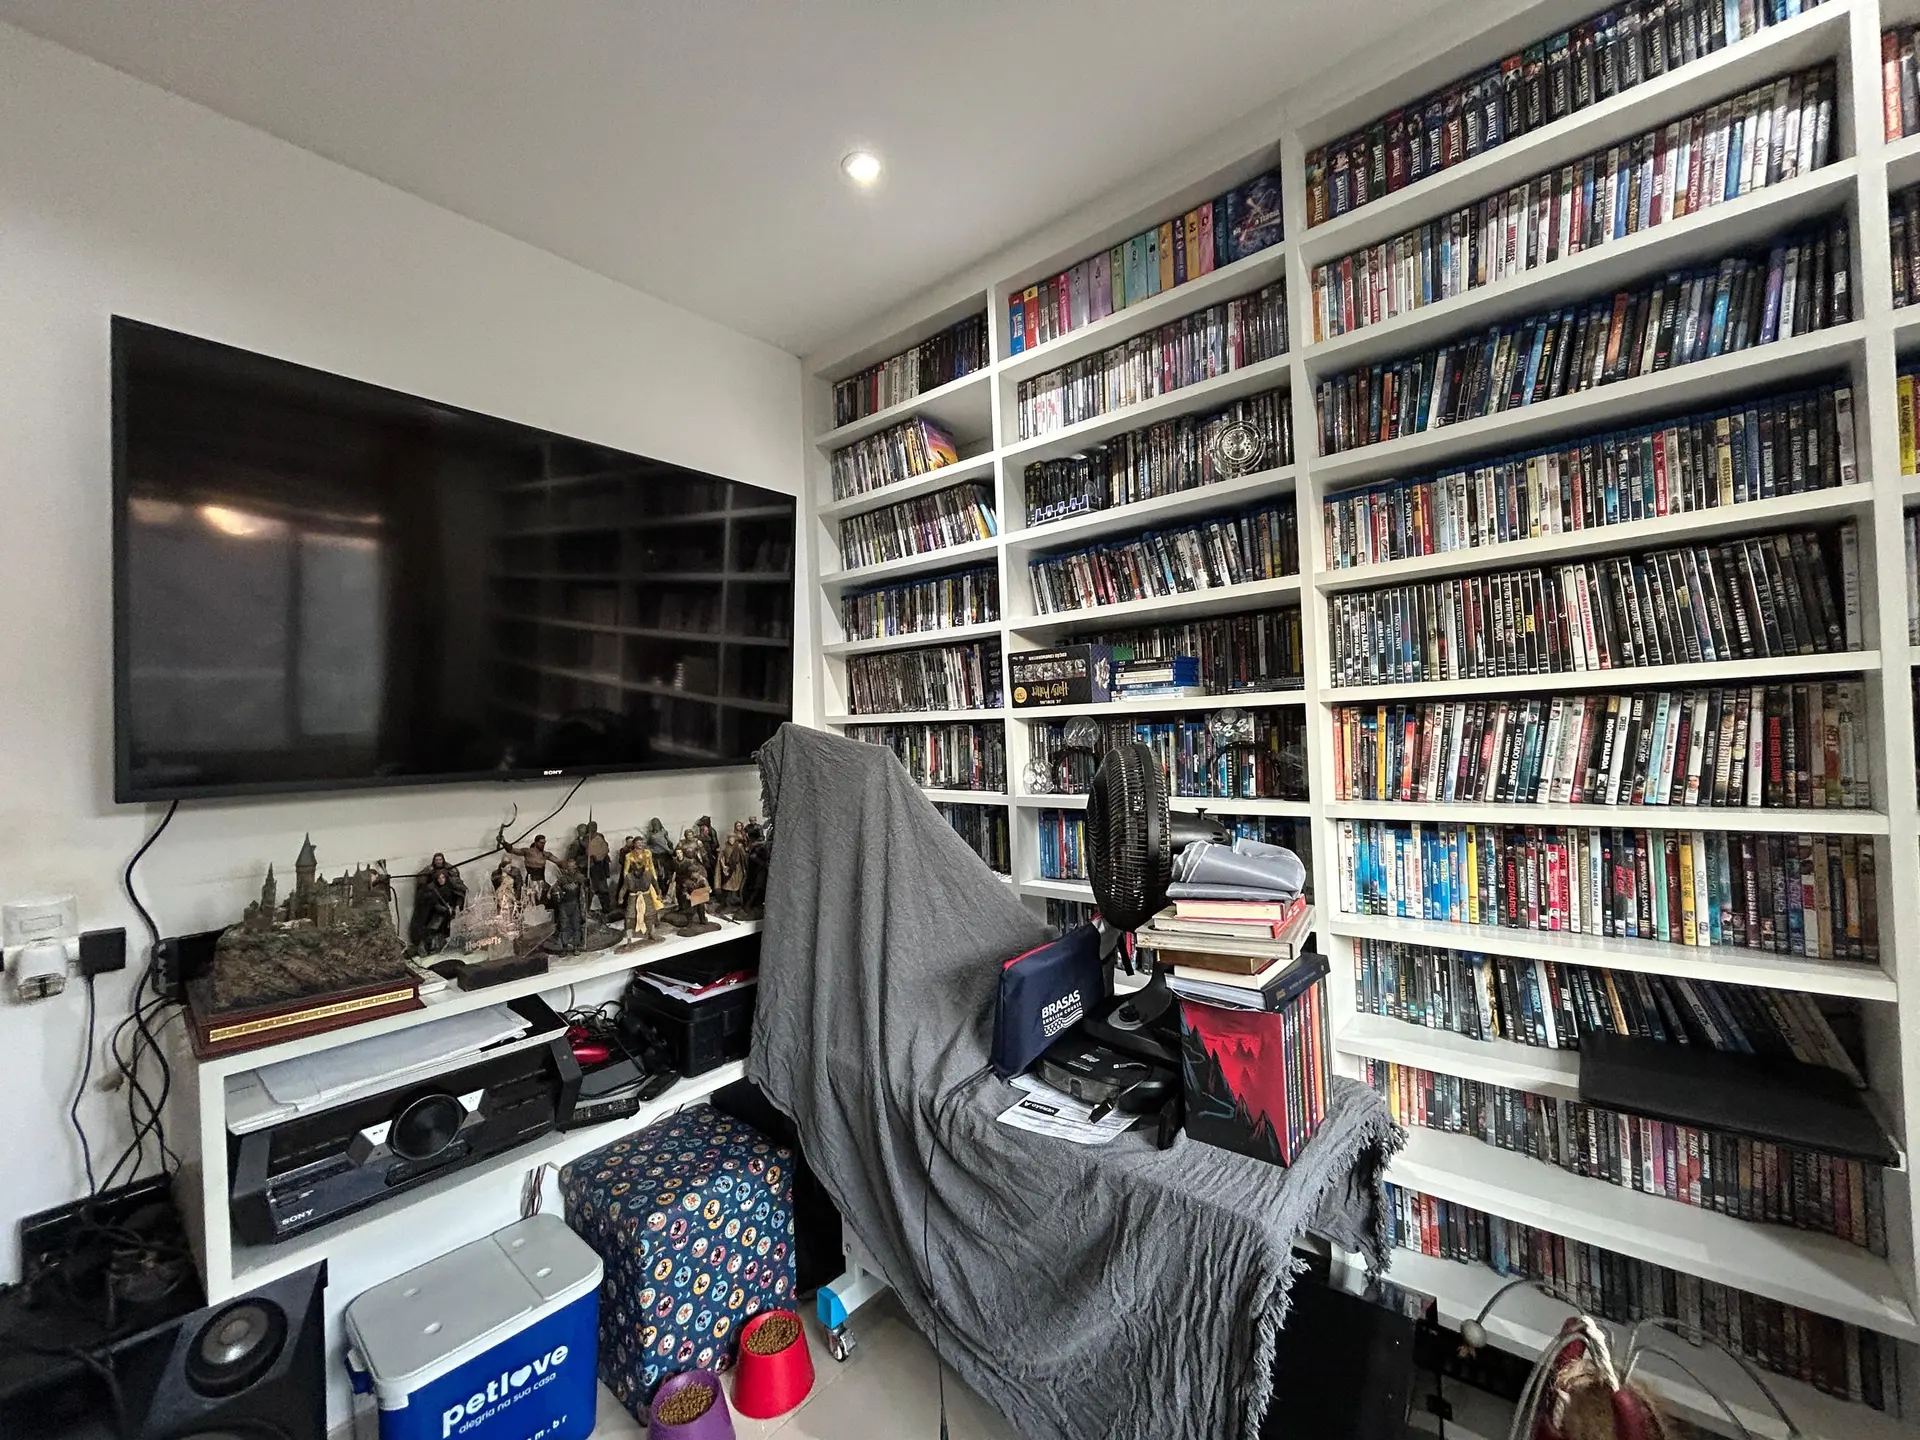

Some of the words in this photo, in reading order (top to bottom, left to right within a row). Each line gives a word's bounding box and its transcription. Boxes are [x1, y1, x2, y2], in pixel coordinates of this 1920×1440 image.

[1405, 502, 1413, 538] PATRICK
[1031, 682, 1050, 699] Potter
[1050, 681, 1069, 697] Harry
[1635, 700, 1644, 716] CREED
[1604, 719, 1615, 742] ROCKY
[1511, 733, 1522, 759] LEGADO
[1601, 742, 1611, 770] BALBOA
[1714, 728, 1733, 781] ADRENALINA
[1508, 760, 1517, 786] BOURNE
[1730, 762, 1743, 788] inferno
[1508, 864, 1519, 918] MERCENÁRIOS
[465, 936, 502, 952] Hogwarts
[1041, 989, 1081, 1019] BRASAS
[281, 1208, 314, 1226] SONY
[458, 1398, 496, 1434] alegria
[497, 1399, 511, 1412] na
[513, 1387, 532, 1403] sua
[533, 1372, 556, 1391] casa
